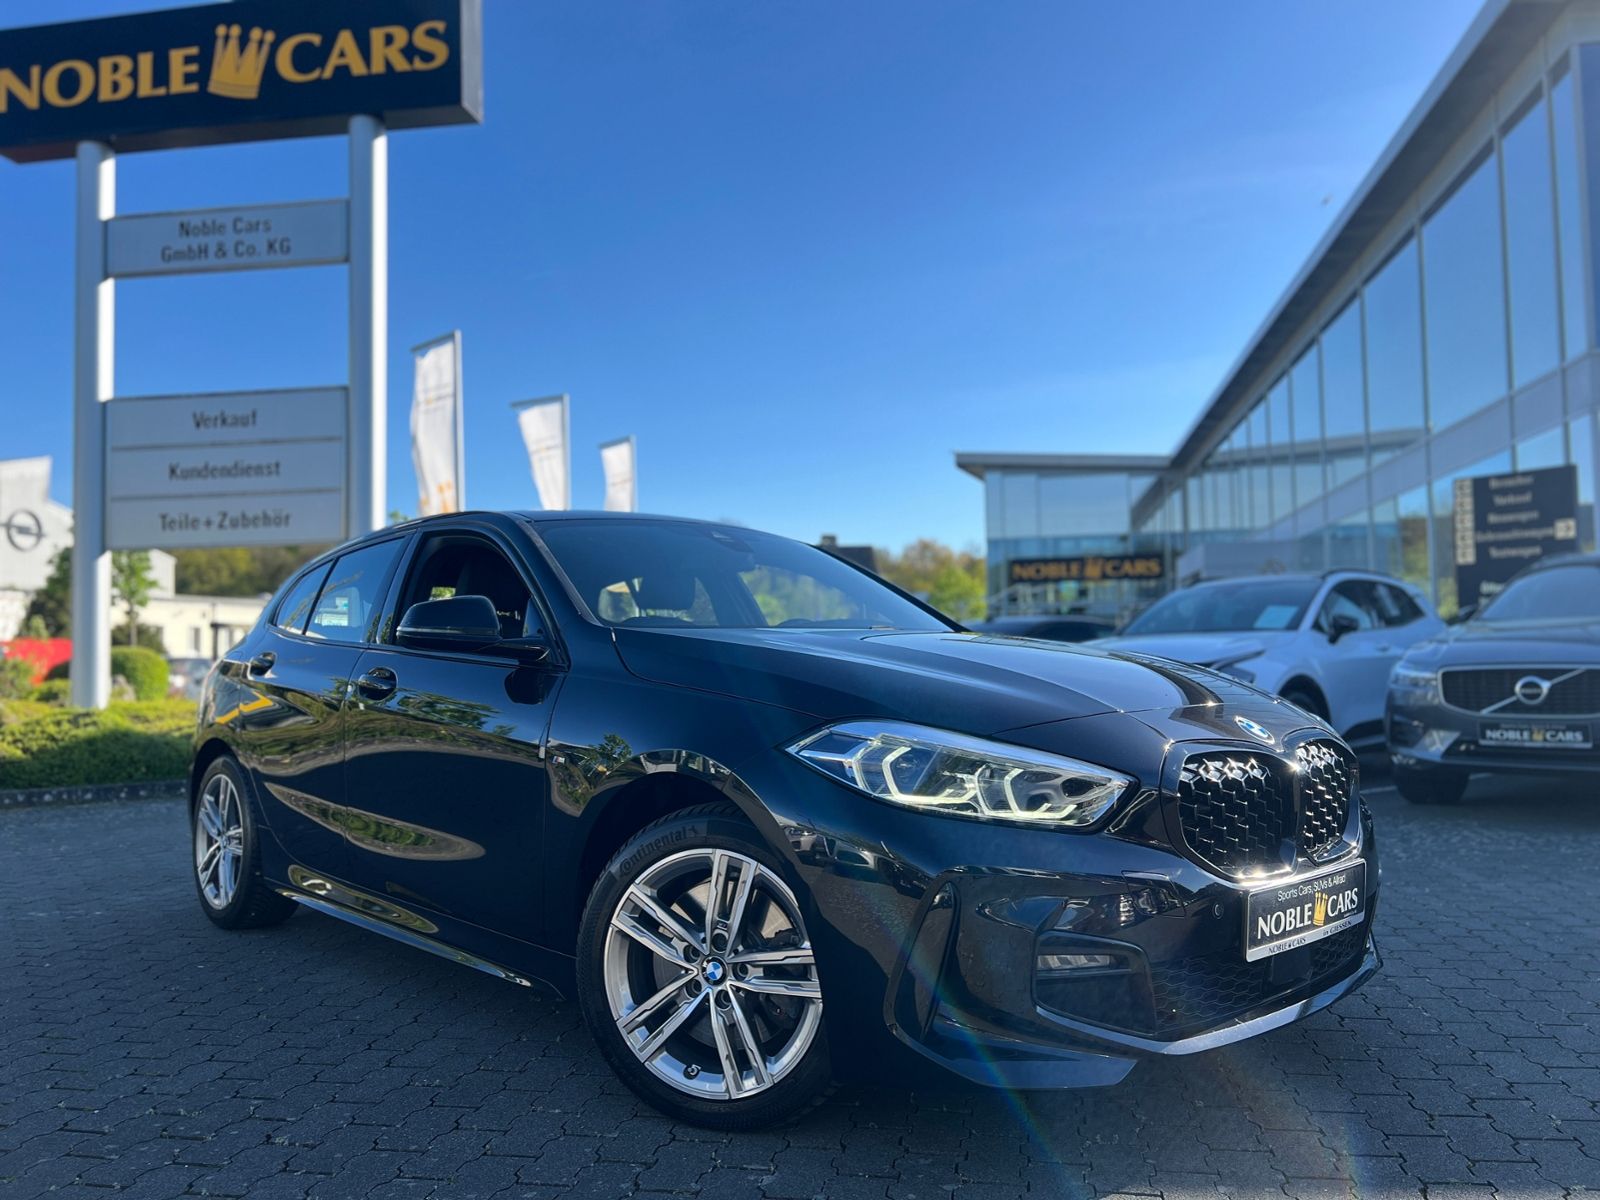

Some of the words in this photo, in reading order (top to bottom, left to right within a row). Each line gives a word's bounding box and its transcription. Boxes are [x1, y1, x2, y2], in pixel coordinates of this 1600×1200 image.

[0, 46, 199, 113] NOBLE
[275, 20, 449, 83] CARS
[178, 220, 226, 238] Noble
[232, 216, 272, 234] Cars
[160, 243, 209, 263] GmbH
[214, 240, 227, 259] &
[234, 239, 261, 257] Co.
[266, 236, 291, 256] KG
[192, 409, 257, 429] Verkauf
[168, 460, 280, 480] Kundendienst
[1012, 561, 1079, 579] NOBLE
[1105, 558, 1160, 577] CARS
[1485, 729, 1530, 740] NOBLE
[1545, 730, 1583, 742] CARS
[619, 825, 688, 876] Continental
[1277, 888, 1298, 903] Sports
[1257, 903, 1312, 939] NOBLE
[1327, 888, 1358, 917] CARS
